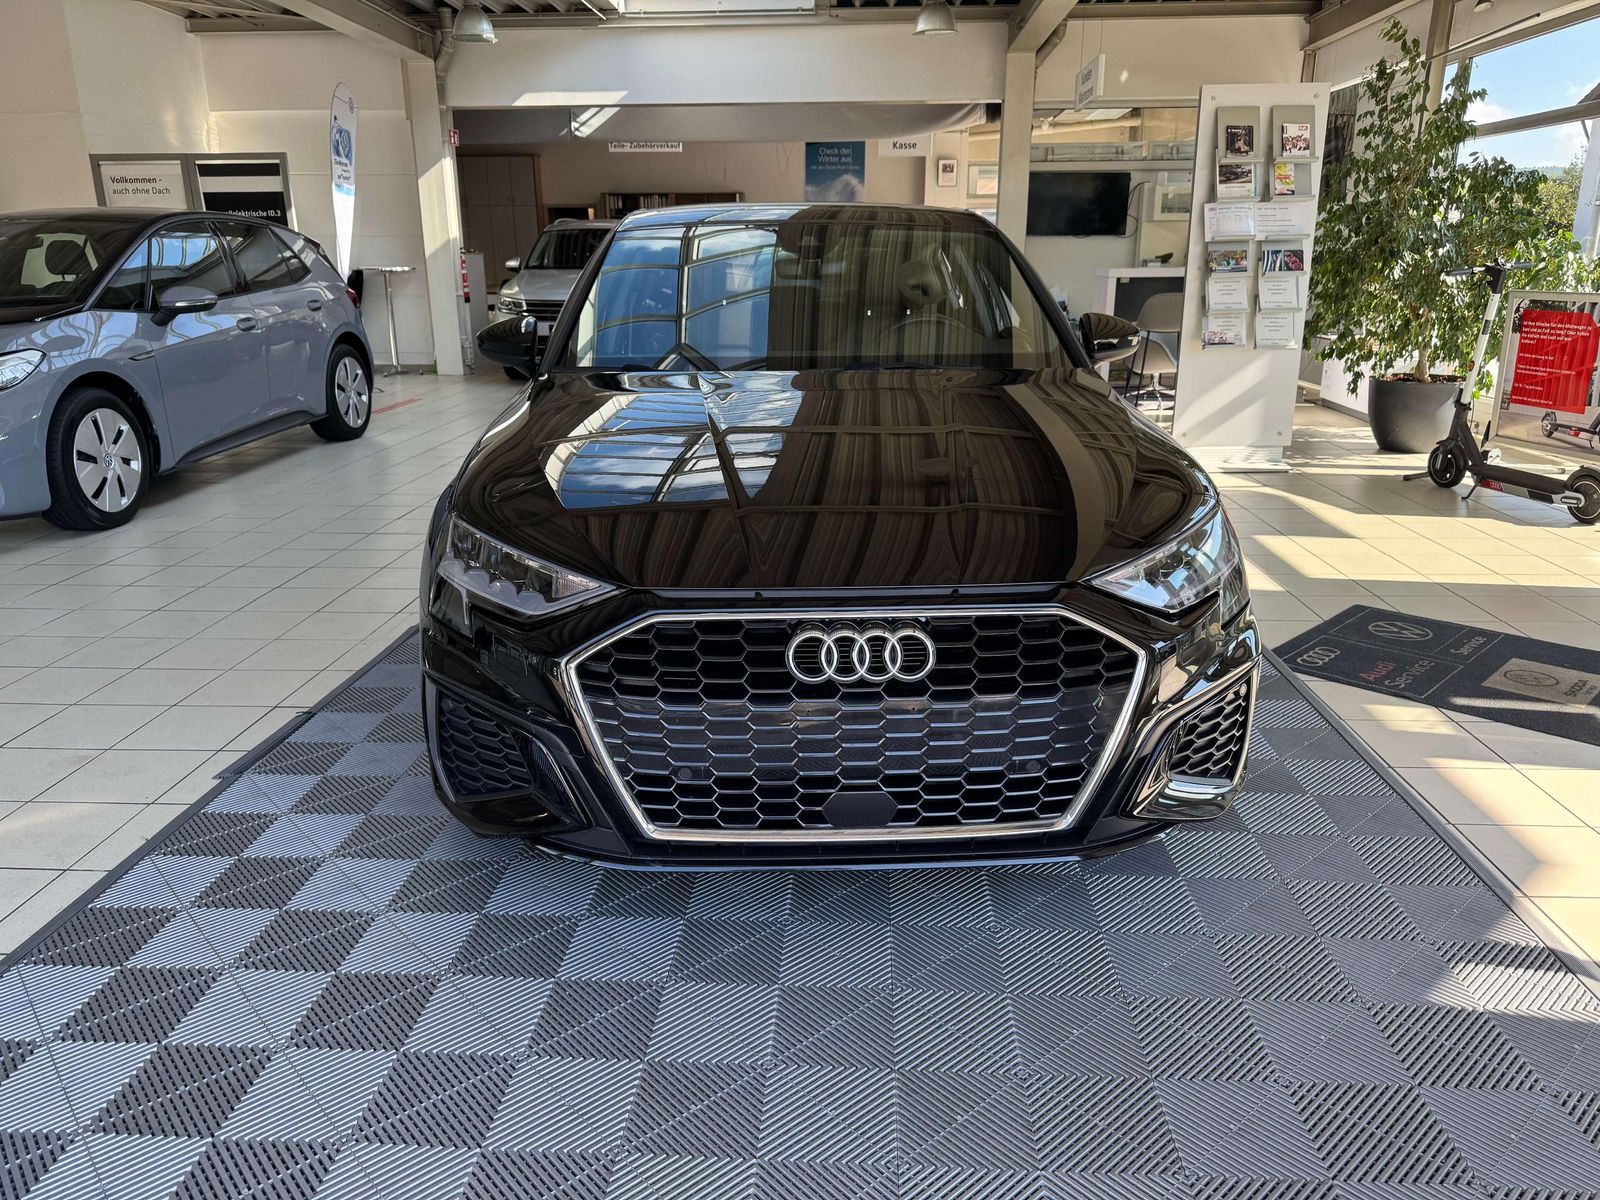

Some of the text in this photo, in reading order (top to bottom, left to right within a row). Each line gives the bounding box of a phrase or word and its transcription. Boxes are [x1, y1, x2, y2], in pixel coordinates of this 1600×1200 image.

[893, 141, 917, 150] Kasse
[819, 146, 839, 155] Check
[110, 176, 157, 184] Vollkommen
[112, 187, 171, 195] auch ohne Dach
[267, 209, 281, 217] ID.3
[1450, 636, 1488, 656] Service
[1359, 660, 1397, 682] Audi
[1384, 659, 1435, 689] Service
